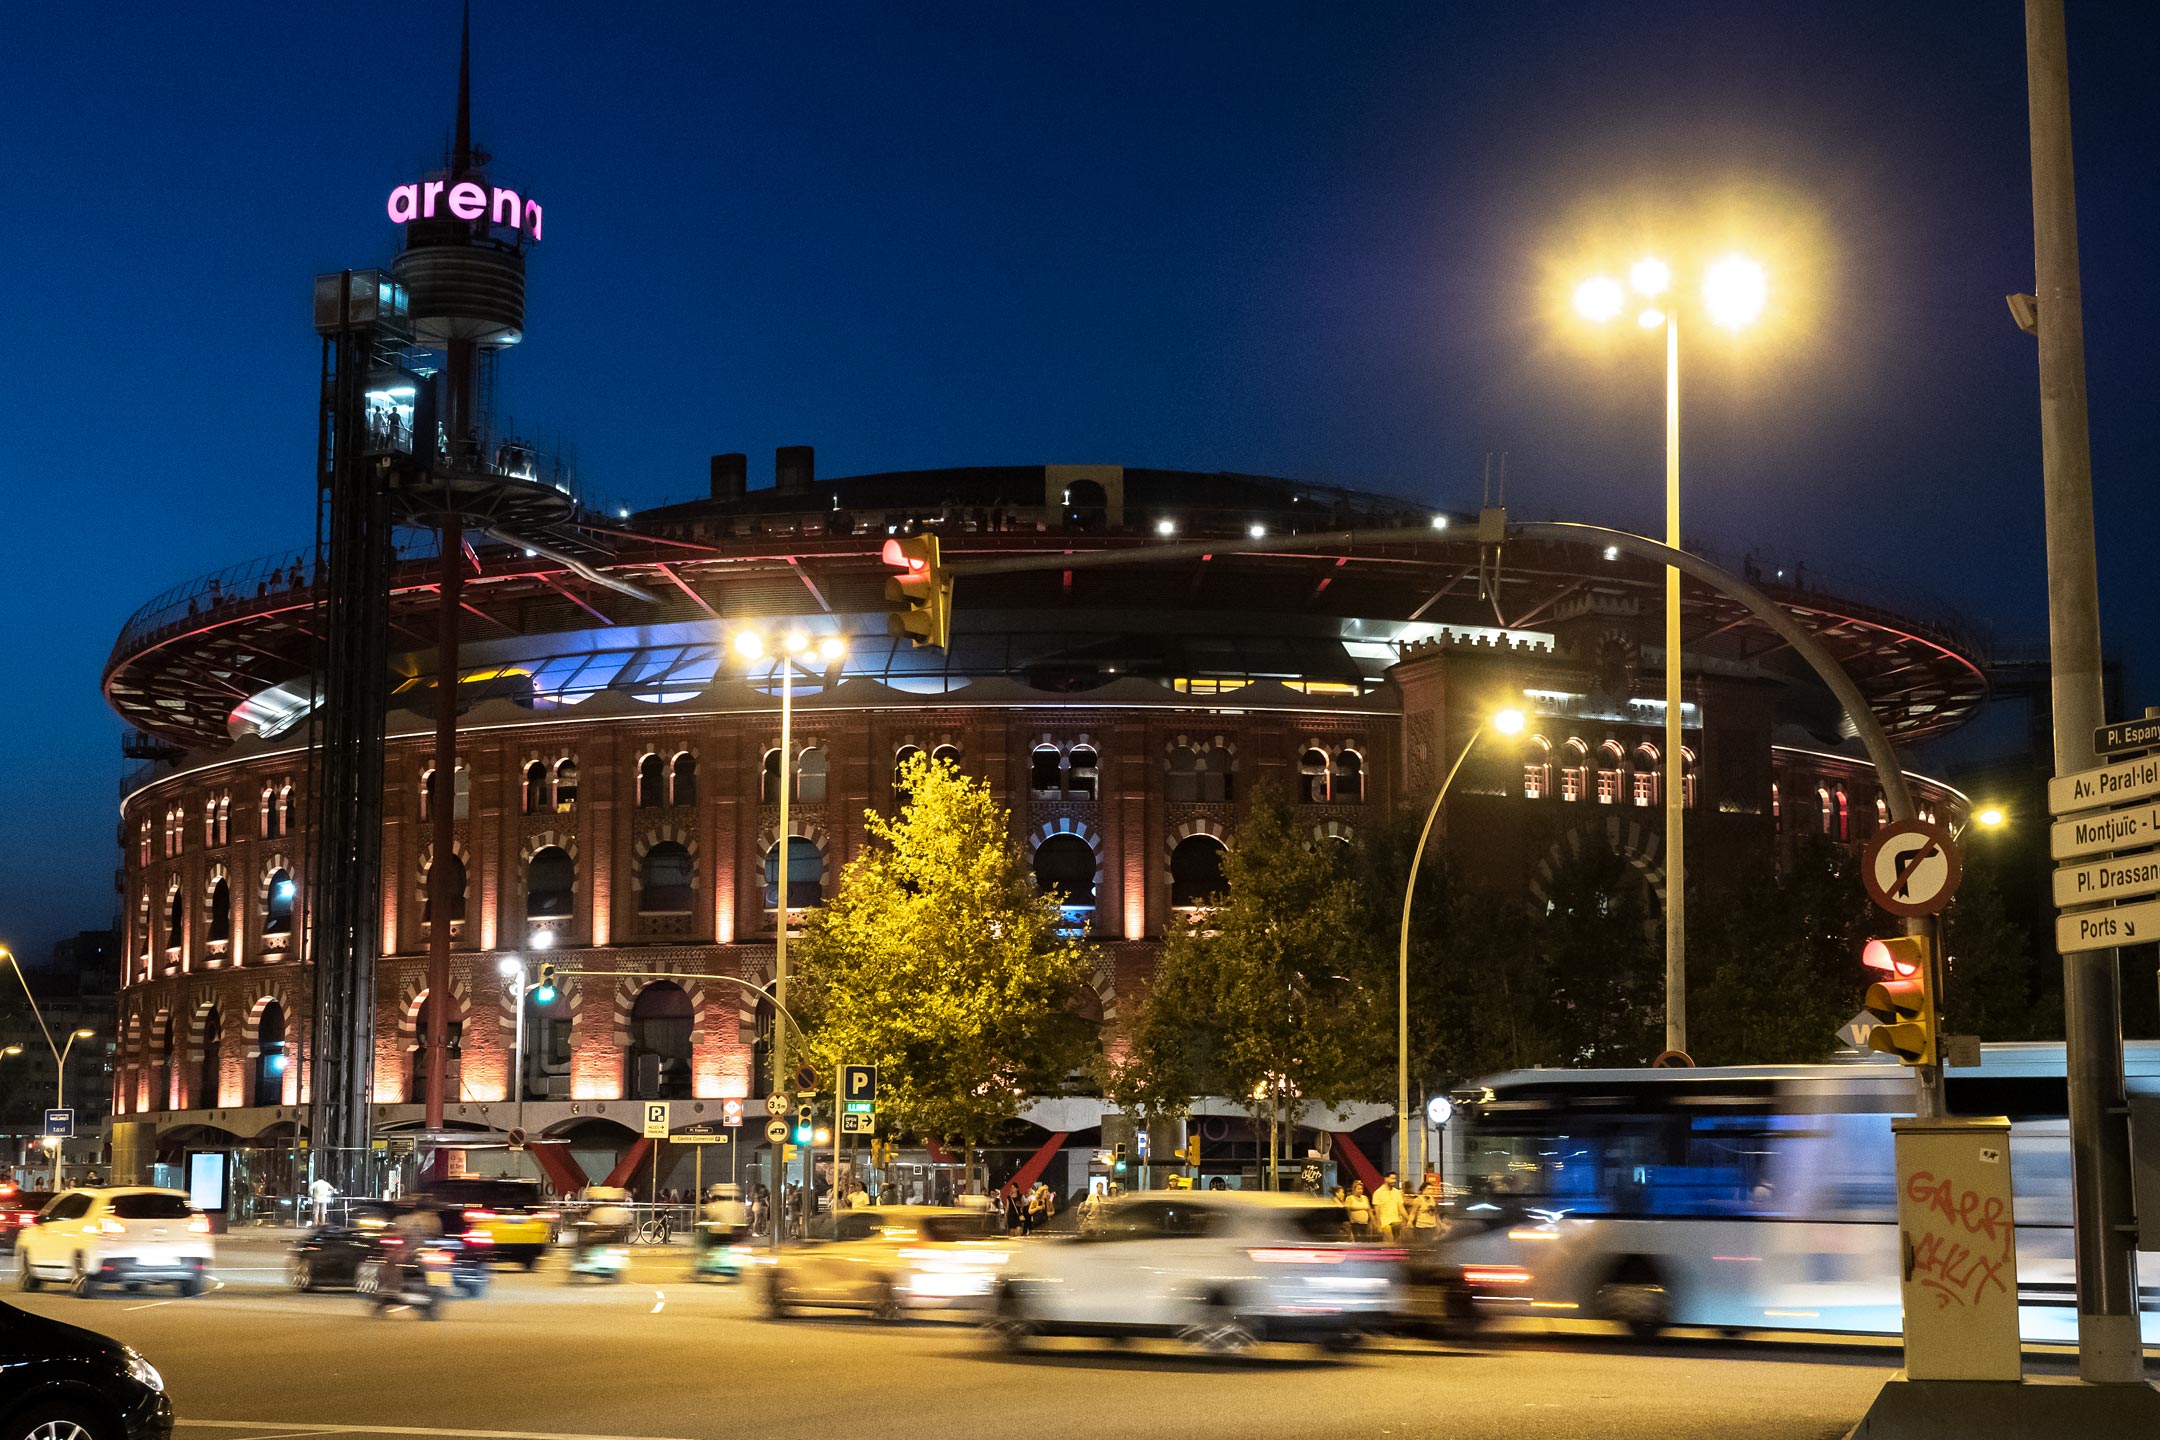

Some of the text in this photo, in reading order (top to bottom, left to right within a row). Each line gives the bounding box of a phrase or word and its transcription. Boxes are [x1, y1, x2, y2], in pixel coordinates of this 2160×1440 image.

[387, 181, 542, 241] arena
[2108, 730, 2121, 746] Pl.
[2074, 779, 2095, 800] Av.
[2076, 816, 2137, 845] Montjuïc
[2078, 864, 2160, 893] Pl. Drassan
[2081, 917, 2117, 940] Ports
[852, 1072, 869, 1095] P
